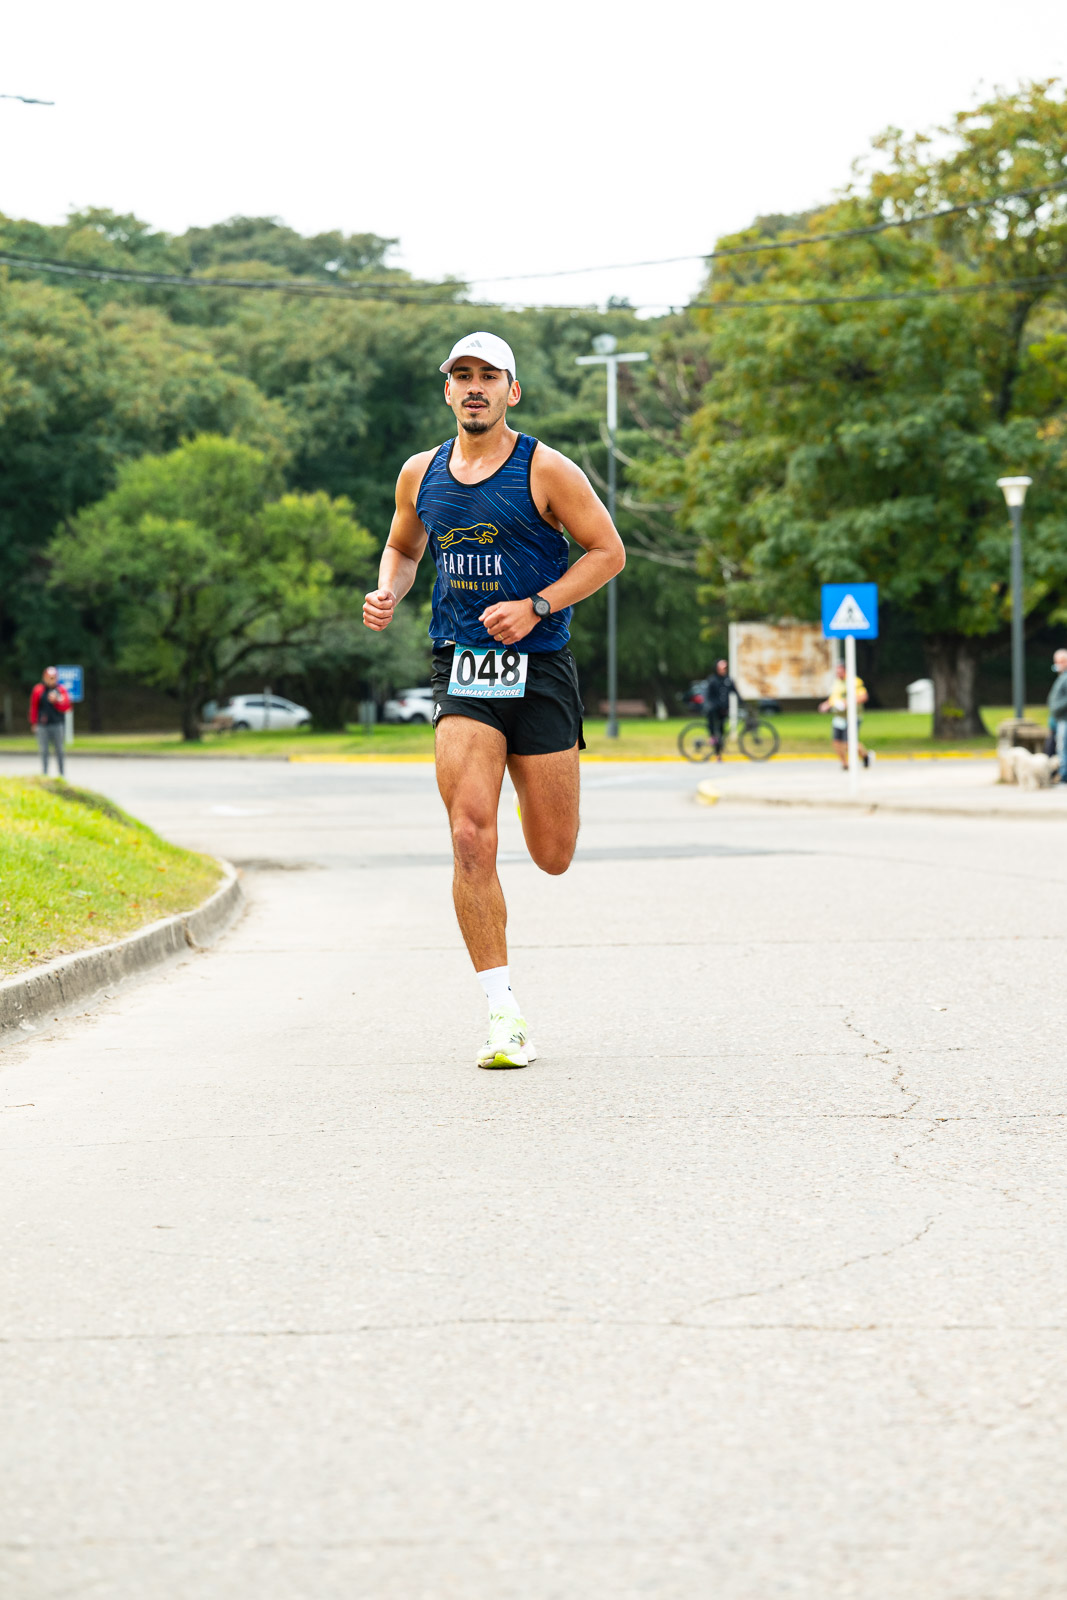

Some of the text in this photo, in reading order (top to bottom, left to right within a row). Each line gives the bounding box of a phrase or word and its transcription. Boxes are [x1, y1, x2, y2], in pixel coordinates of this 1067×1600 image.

[443, 552, 503, 576] FARTLEK
[481, 581, 499, 591] CLUB
[456, 649, 521, 687] 048
[452, 688, 493, 697] DIAMANTE
